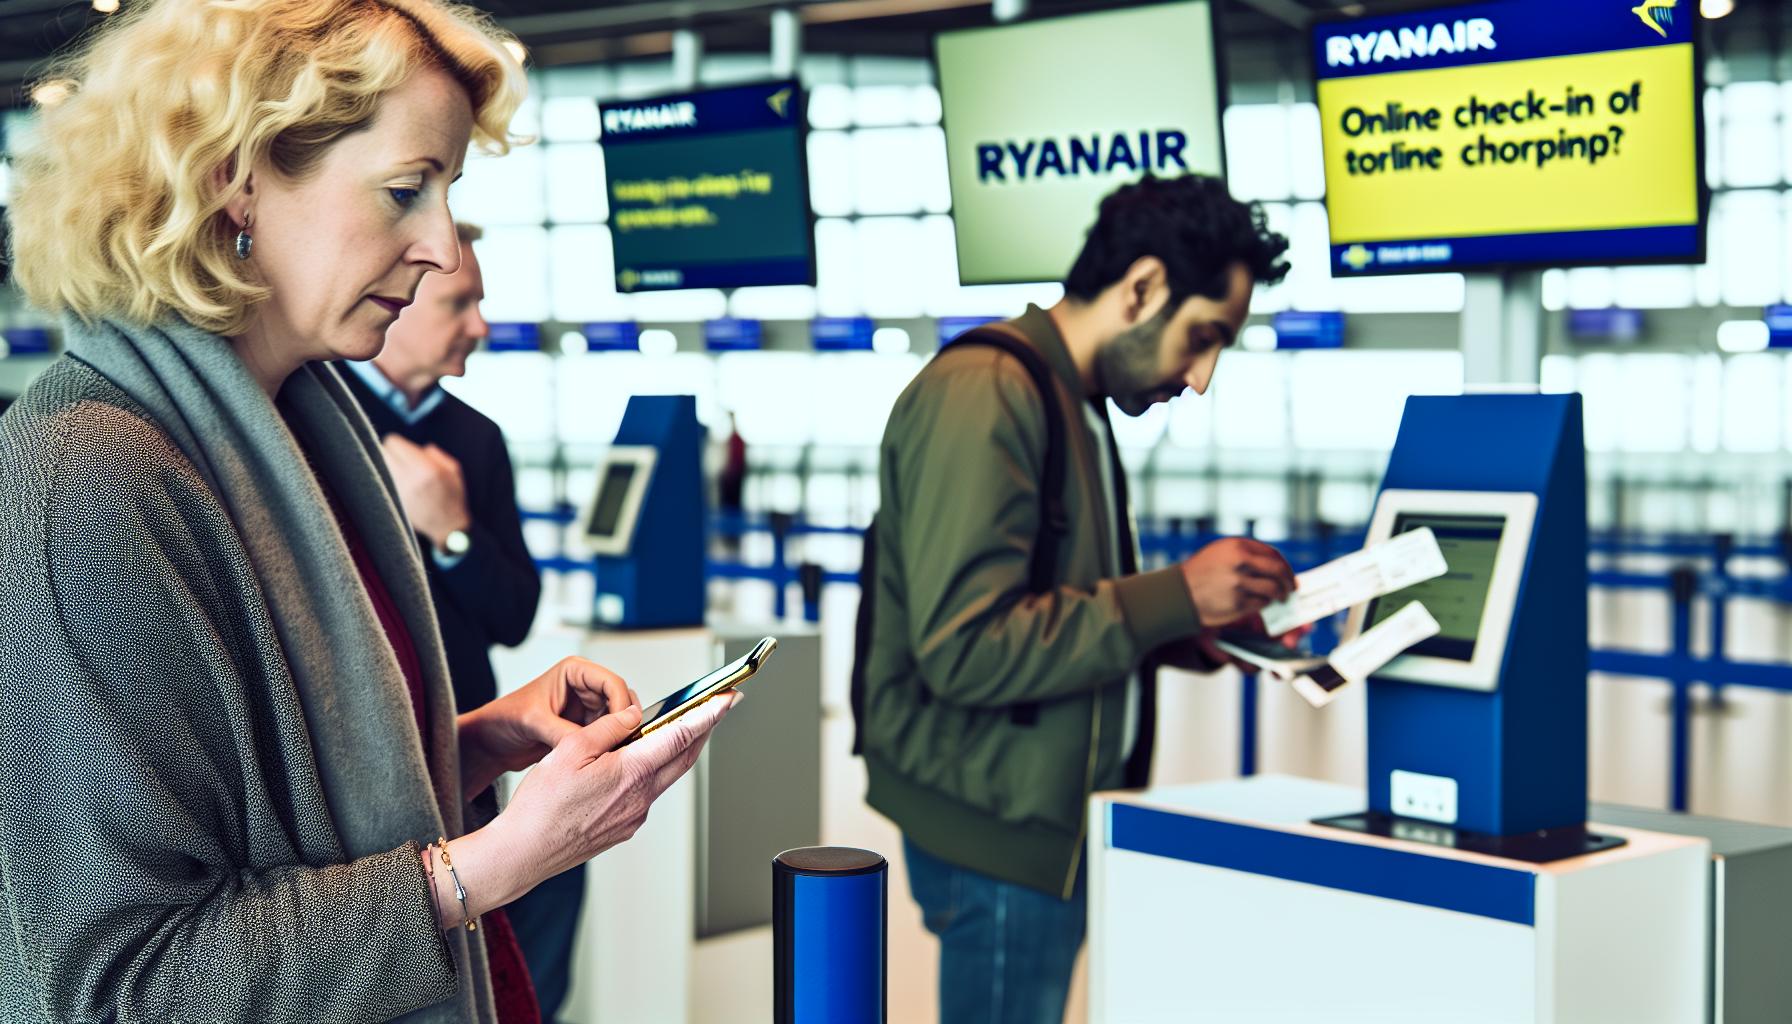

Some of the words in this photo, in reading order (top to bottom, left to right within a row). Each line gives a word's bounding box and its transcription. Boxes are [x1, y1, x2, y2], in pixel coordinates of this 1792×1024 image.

[1326, 18, 1497, 67] RYANAIR
[1341, 103, 1441, 137] Online
[1454, 86, 1595, 127] check-in
[1608, 81, 1642, 114] of
[976, 130, 1187, 184] RYANAIR
[1345, 143, 1442, 175] torline
[1461, 125, 1625, 168] chorpinp?
